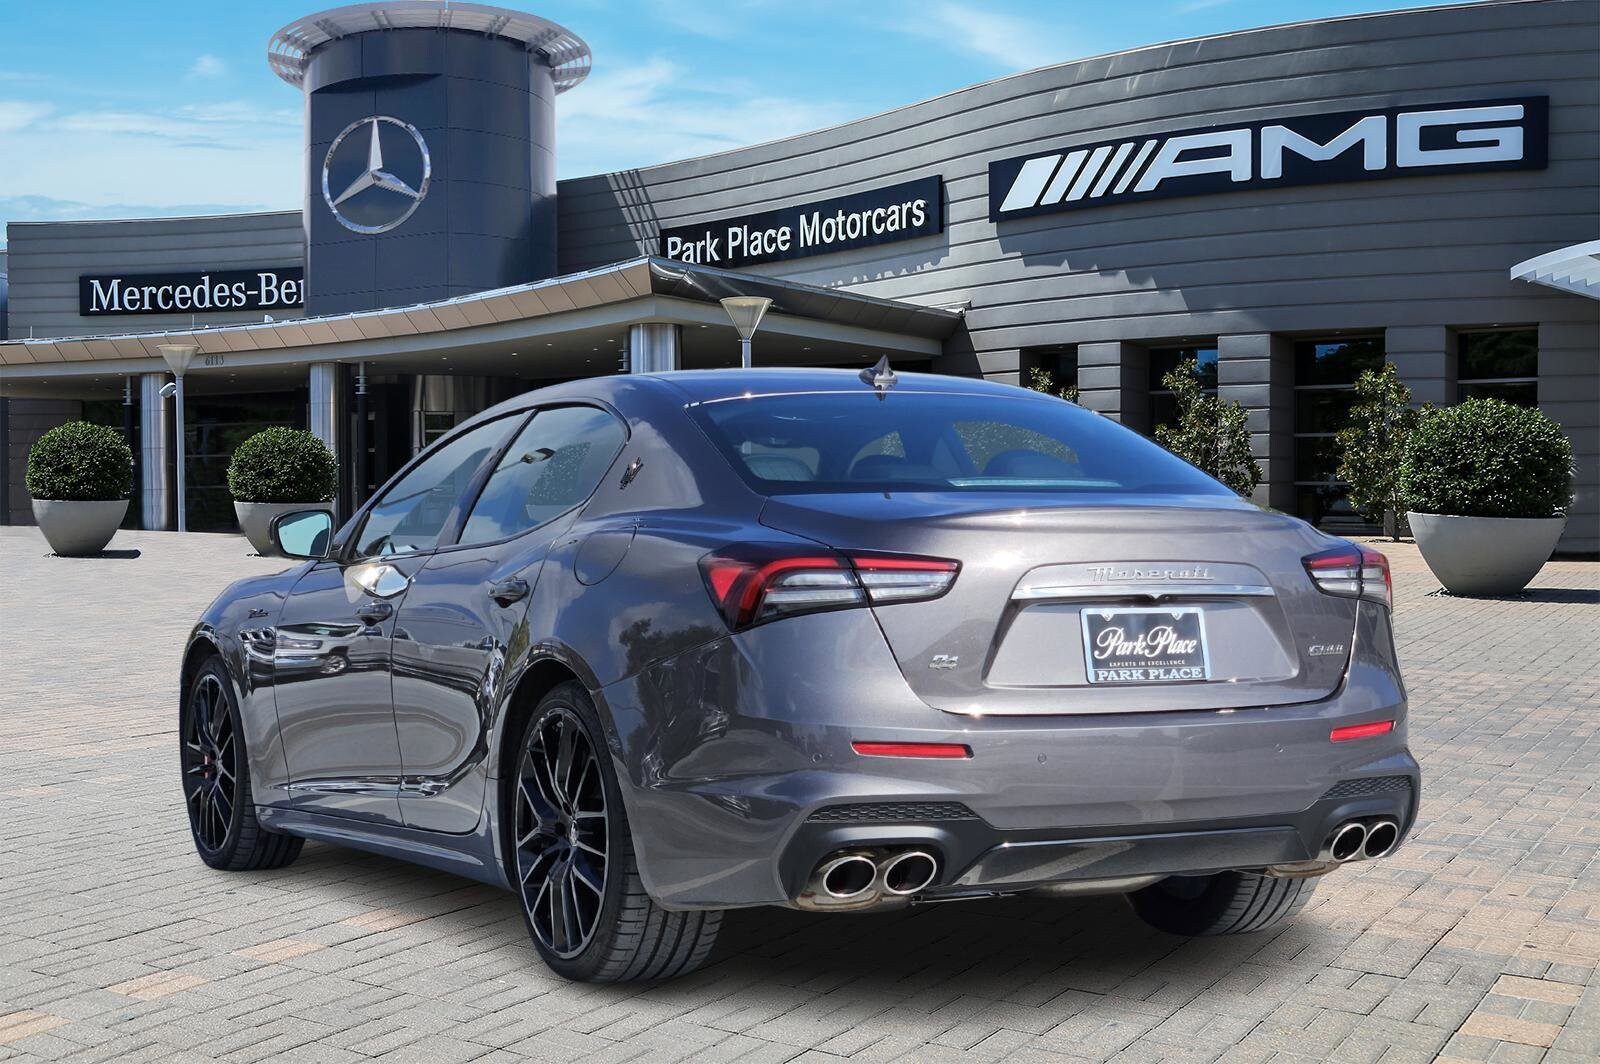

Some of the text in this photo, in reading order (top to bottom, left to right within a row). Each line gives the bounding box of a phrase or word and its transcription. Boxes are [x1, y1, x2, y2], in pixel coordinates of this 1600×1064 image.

[667, 199, 927, 264] Park Place Motorcars
[1087, 566, 1215, 582] Maserati
[1094, 626, 1197, 659] Park Place
[1097, 667, 1203, 681] PARK PLACE
